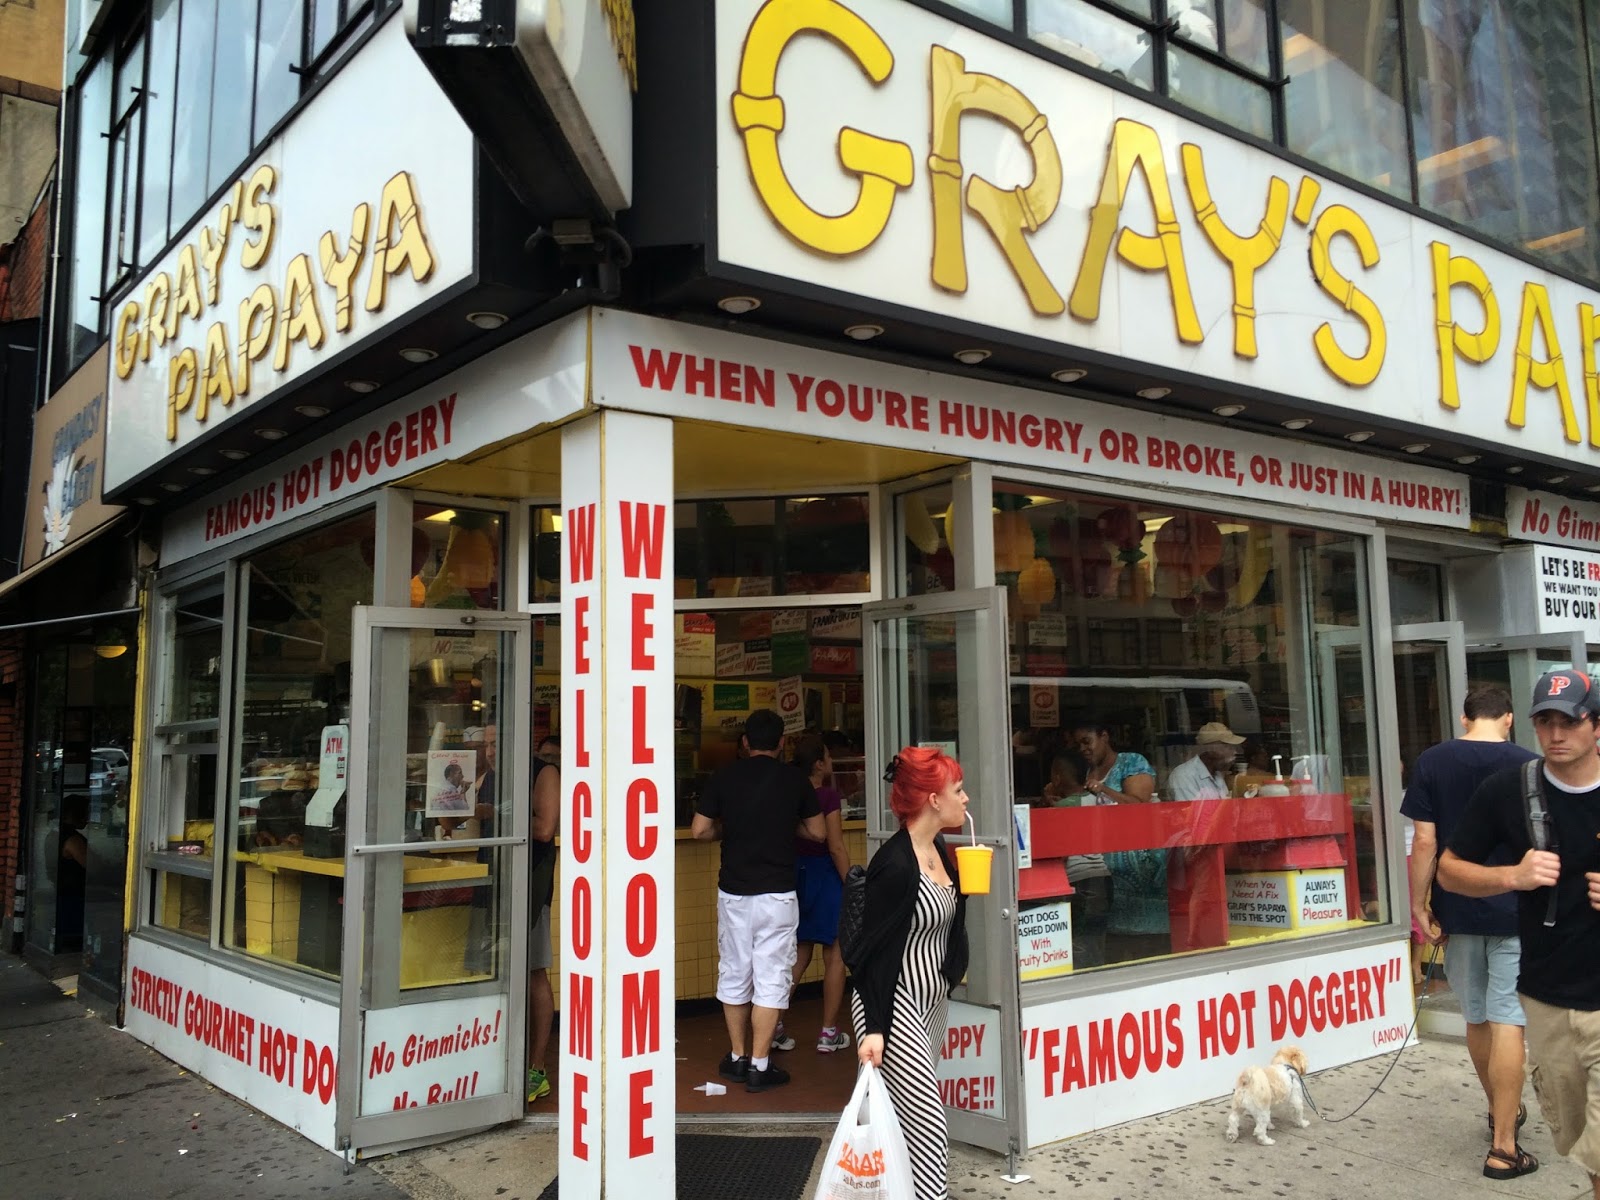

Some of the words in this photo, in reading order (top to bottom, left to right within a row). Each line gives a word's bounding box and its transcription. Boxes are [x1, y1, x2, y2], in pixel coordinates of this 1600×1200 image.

[731, 0, 1387, 388] GRAY'S
[116, 165, 275, 380] GRAY'S
[167, 170, 434, 441] PAPAYA
[629, 345, 775, 407] WHEN
[787, 373, 930, 431] YOU'RE
[940, 400, 1092, 463] HUNGRY,
[1100, 428, 1140, 465] OR
[1147, 438, 1245, 486] BROKE,
[1249, 454, 1283, 486] OR
[1288, 463, 1338, 495] JUST
[1342, 471, 1366, 500] IN
[1371, 475, 1385, 502] A
[1388, 480, 1461, 515] HURRY!
[205, 482, 276, 541] FAMOUS
[282, 457, 324, 512] HOT
[329, 392, 458, 491] DOGGERY
[1521, 498, 1550, 535] No
[1542, 556, 1569, 578] LET'S
[1572, 560, 1586, 580] BE
[1544, 581, 1557, 593] WE
[1559, 582, 1581, 595] WANT
[1583, 585, 1598, 597] YOU
[1545, 597, 1569, 618] BUY
[1572, 599, 1597, 620] OUR
[1548, 675, 1571, 696] P
[325, 737, 343, 754] ATM
[568, 503, 596, 1162] WELCOME
[619, 501, 666, 1159] WELCOME
[1232, 890, 1254, 899] Need
[1266, 891, 1279, 900] Fix
[1235, 879, 1258, 889] When
[1261, 880, 1276, 889] You
[1305, 880, 1336, 892] ALWAYS
[1257, 903, 1287, 913] PAPAYA
[1304, 895, 1311, 905] A
[1312, 893, 1338, 905] GUILTY
[1018, 914, 1034, 926] HOT
[1036, 911, 1060, 923] DOGS
[1230, 912, 1247, 922] HITS
[1248, 913, 1263, 922] THE
[1265, 914, 1286, 924] SPOT
[1303, 907, 1343, 921] Pleasure
[1018, 925, 1043, 938] ASHED
[1045, 921, 1068, 934] DOWN
[1031, 937, 1052, 951] With
[1019, 953, 1041, 967] ruity
[1043, 948, 1069, 963] Drinks
[131, 966, 183, 1028] STRICTLY
[184, 990, 255, 1066] GOURMET
[259, 1022, 298, 1088] HOT
[303, 1039, 339, 1105] DO
[1198, 990, 1257, 1060] HOT
[1372, 1023, 1408, 1048] (ANON)
[369, 1041, 395, 1080] No
[402, 1010, 502, 1068] Gimmicks!
[940, 1024, 986, 1060] APPY
[937, 1076, 995, 1110] VICE!!
